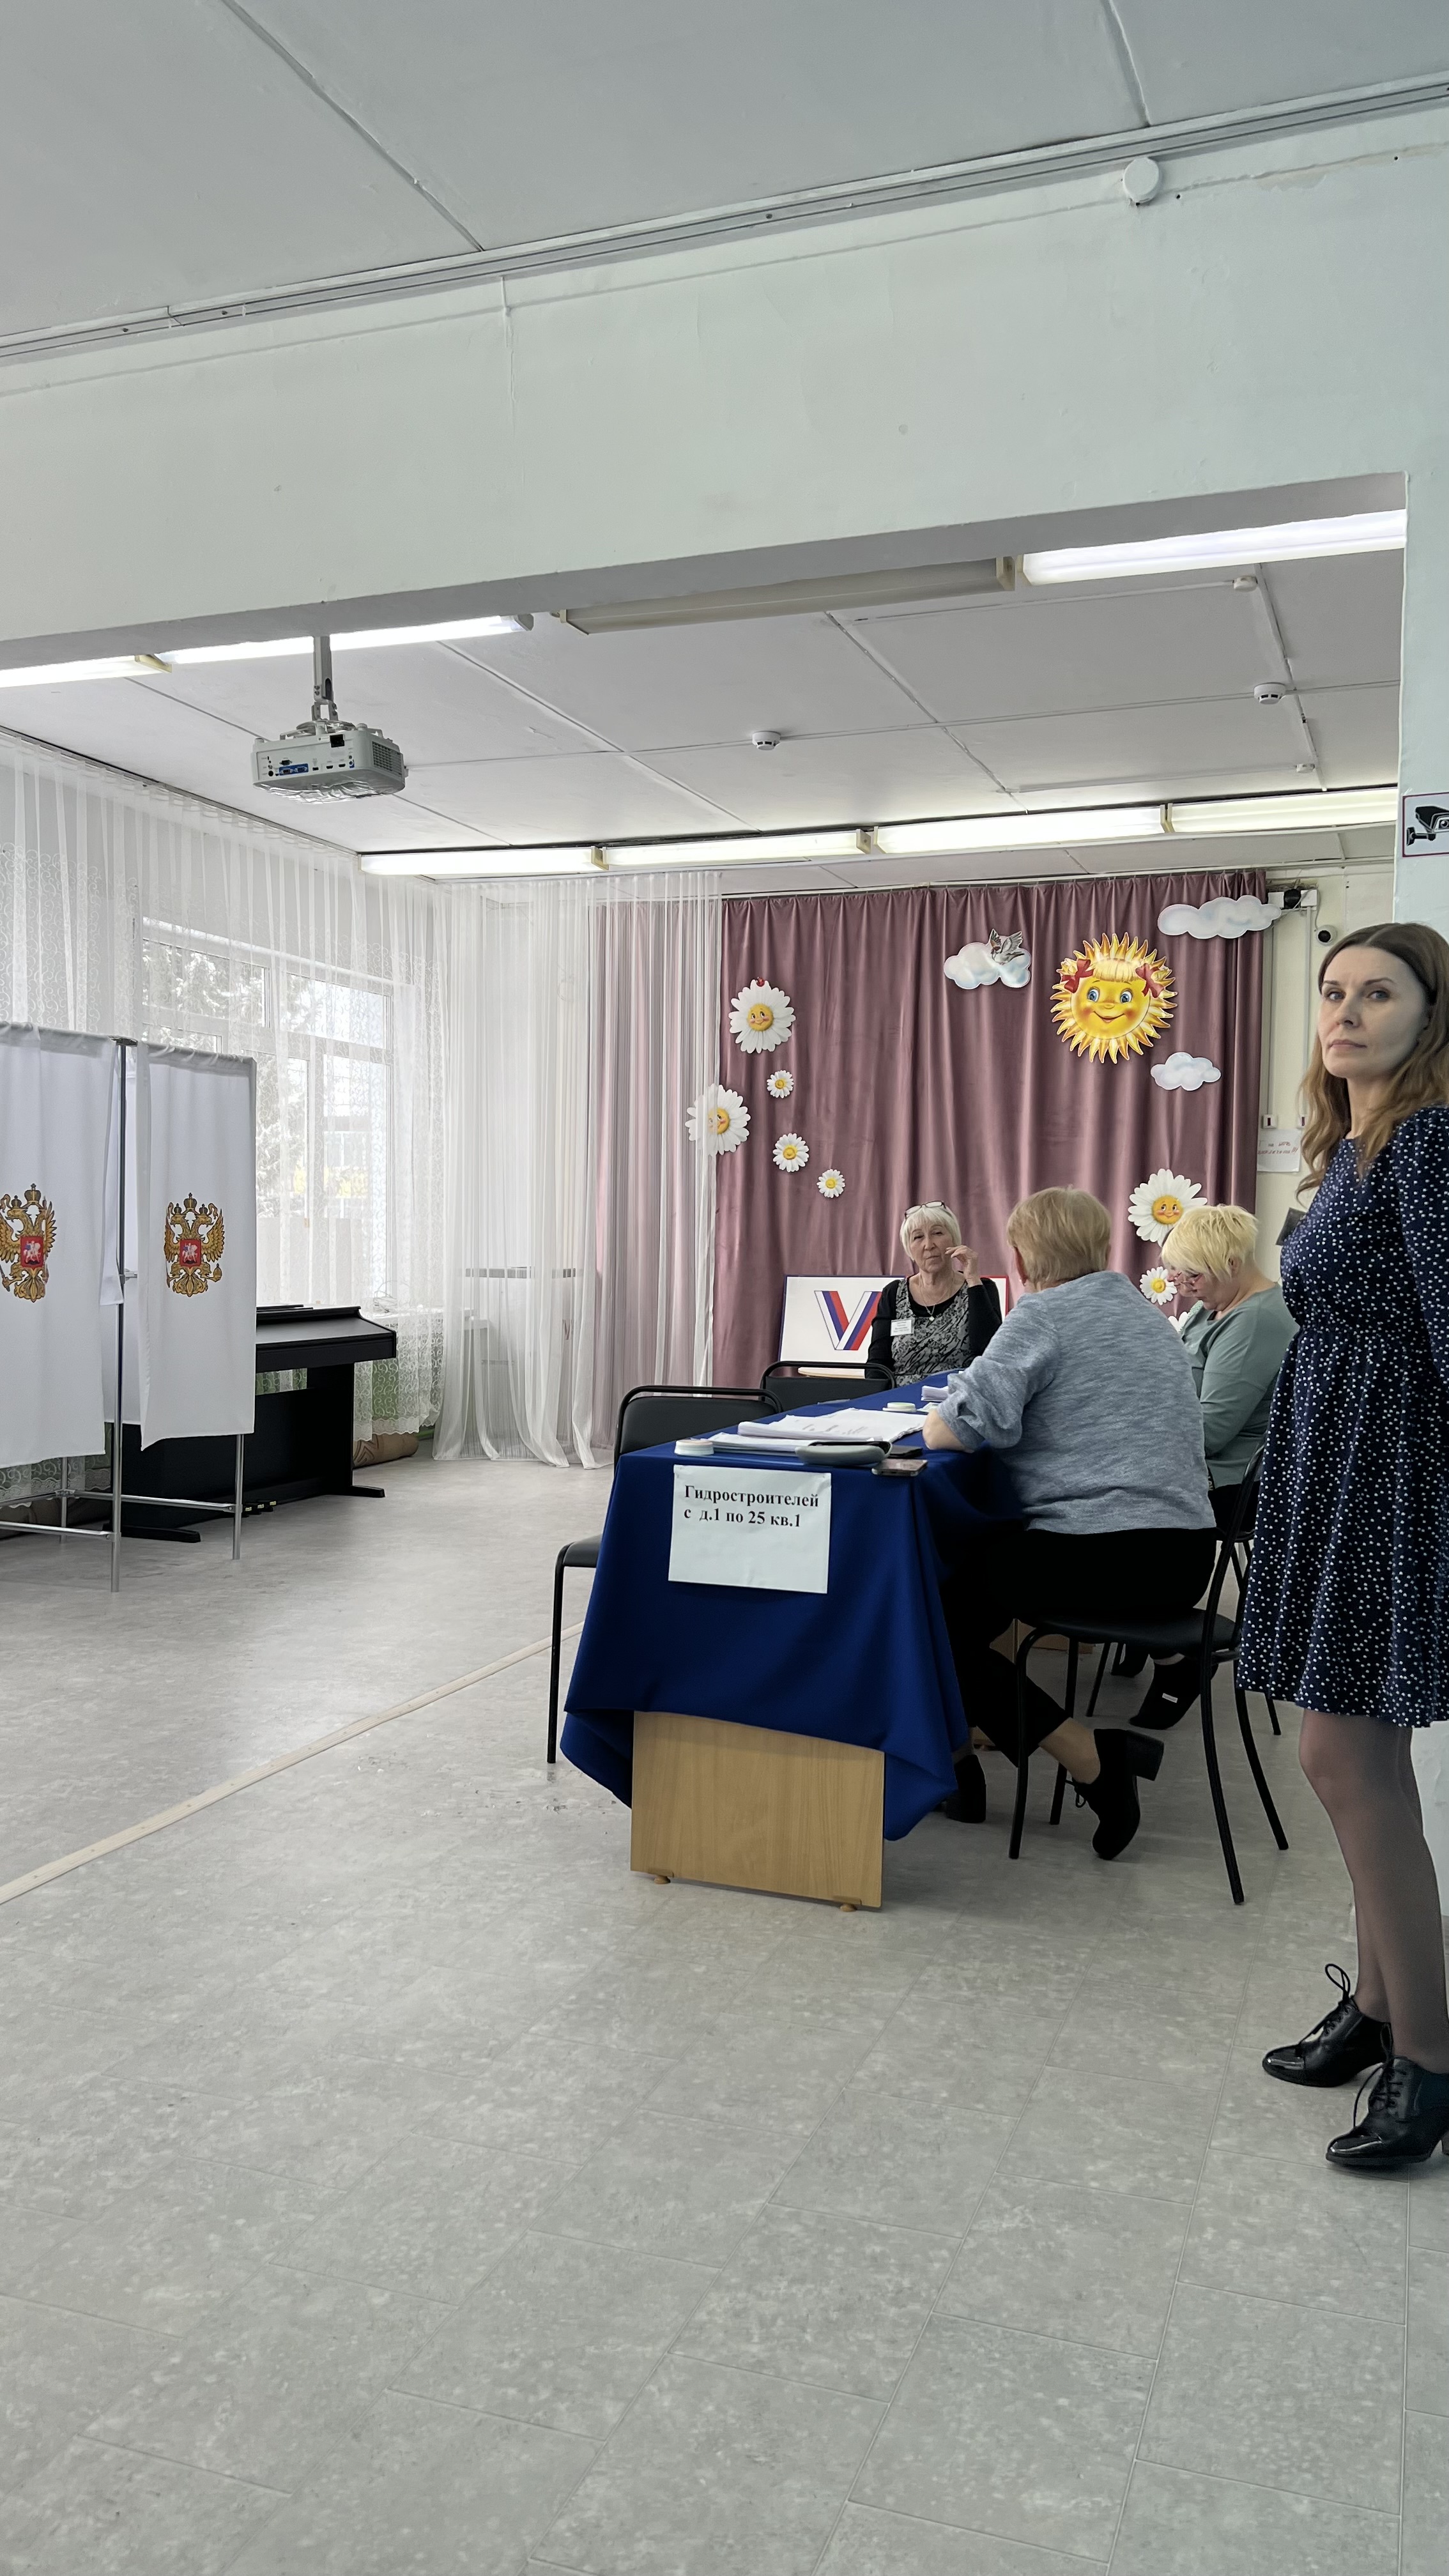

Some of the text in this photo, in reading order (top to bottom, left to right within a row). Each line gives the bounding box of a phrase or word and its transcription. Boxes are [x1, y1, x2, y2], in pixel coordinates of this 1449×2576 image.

[684, 1485, 819, 1507] Гидростроителей
[684, 1508, 801, 1527] с д.1 по 25 кв.1
